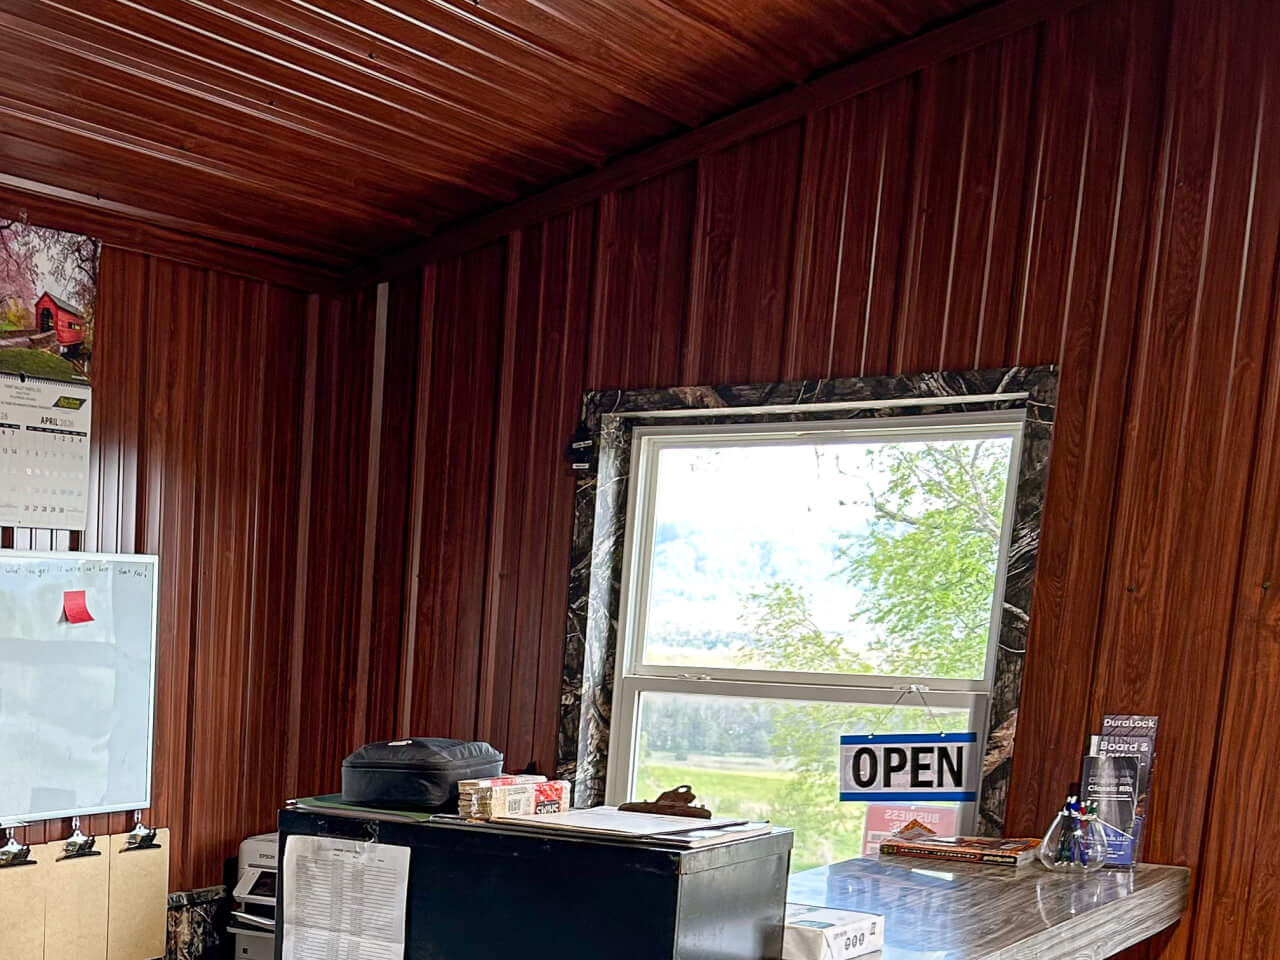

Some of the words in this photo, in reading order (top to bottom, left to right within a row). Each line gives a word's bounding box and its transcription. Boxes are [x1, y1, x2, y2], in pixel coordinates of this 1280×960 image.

[40, 416, 58, 426] APRIL
[1103, 718, 1155, 728] DuraLock
[1100, 741, 1138, 751] Board
[852, 746, 963, 788] OPEN
